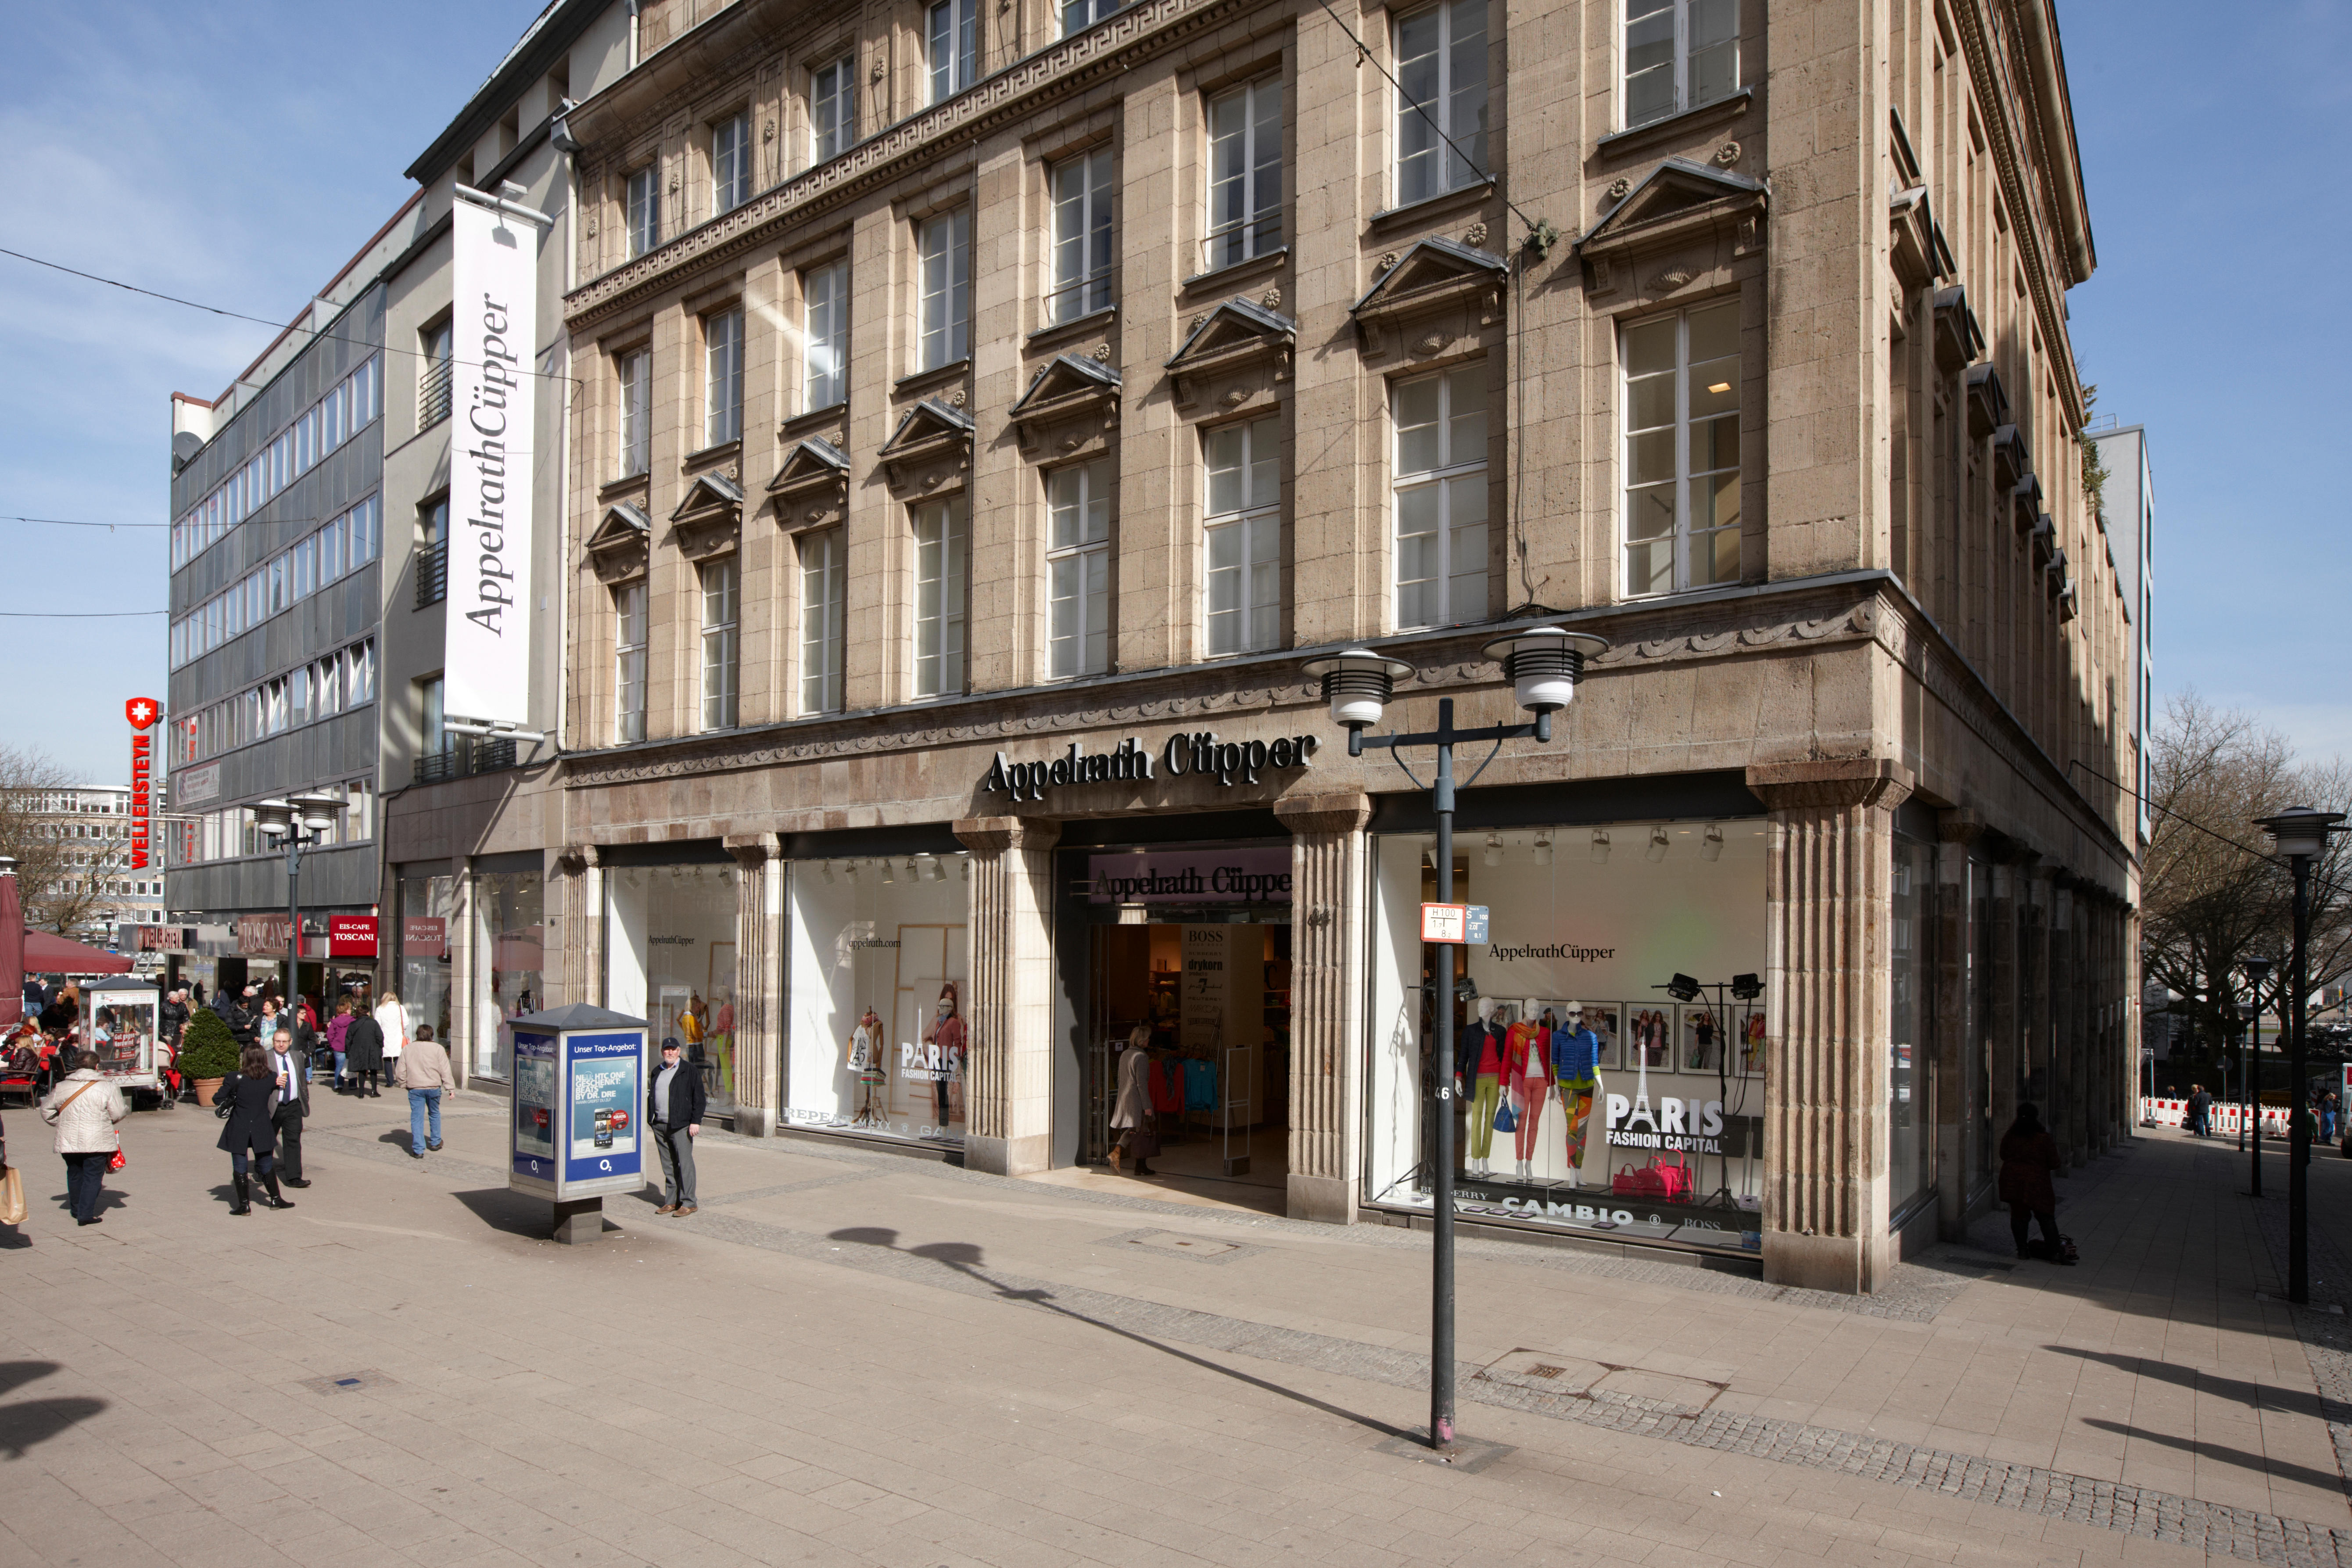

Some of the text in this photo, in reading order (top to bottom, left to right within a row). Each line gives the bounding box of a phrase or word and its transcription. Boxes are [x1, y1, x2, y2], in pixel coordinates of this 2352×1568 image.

[465, 292, 519, 637] AppelrathCüpper
[983, 732, 1322, 802] Appelrath Cüpper
[132, 735, 150, 870] WELLENSTEYN
[1094, 866, 1292, 903] Appelrath Cüppe
[648, 935, 695, 947] AppelrathCüpper
[1189, 930, 1223, 942] BOSS
[848, 937, 901, 951] appelrath.com
[1488, 943, 1615, 962] AppelrathCüpper
[1188, 958, 1223, 971] drykorn
[594, 1043, 636, 1053] Top-Angebot:
[575, 1078, 621, 1088] GESCHENKT:
[901, 1068, 957, 1083] FASHION CAPITAL
[1435, 1086, 1450, 1100] 46
[783, 1107, 853, 1124] REPEAT
[1606, 1131, 1721, 1154] FASHION CAPITAL
[1502, 1197, 1634, 1225] CAMBIO
[1684, 1217, 1721, 1232] BOSS
